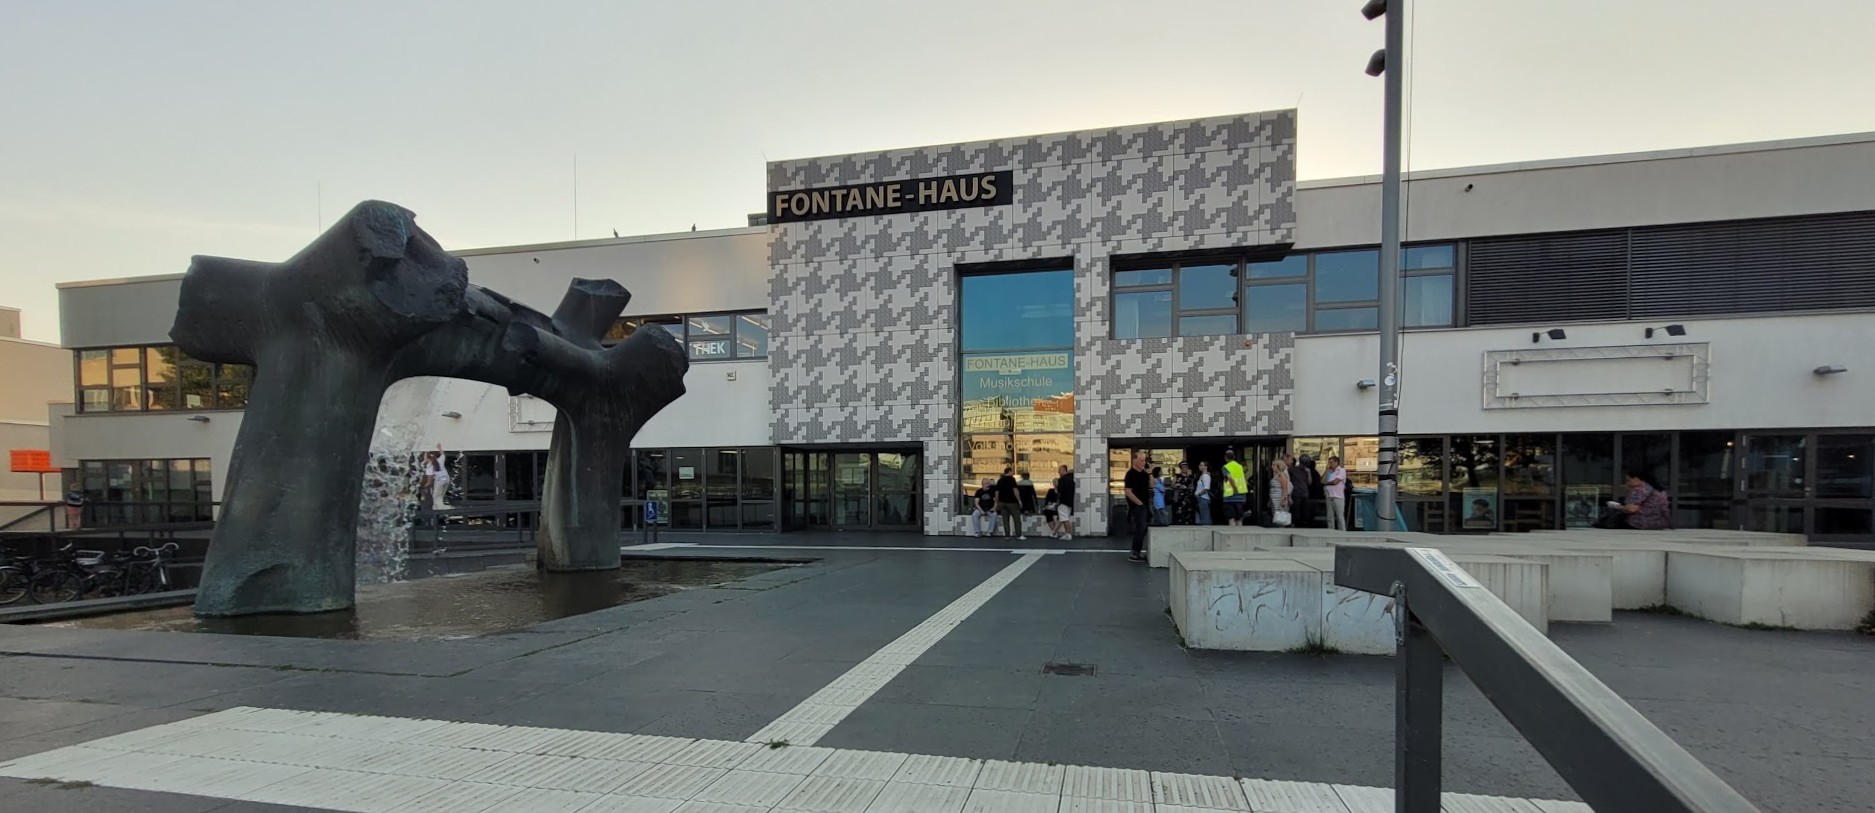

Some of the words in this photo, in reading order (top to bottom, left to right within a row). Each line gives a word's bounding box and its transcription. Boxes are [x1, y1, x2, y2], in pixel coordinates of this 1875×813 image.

[775, 175, 997, 217] FONTANE-HAUS
[693, 341, 726, 356] THEK
[967, 355, 1066, 369] FONTANE-HAUS
[980, 376, 1053, 389] Musikschule
